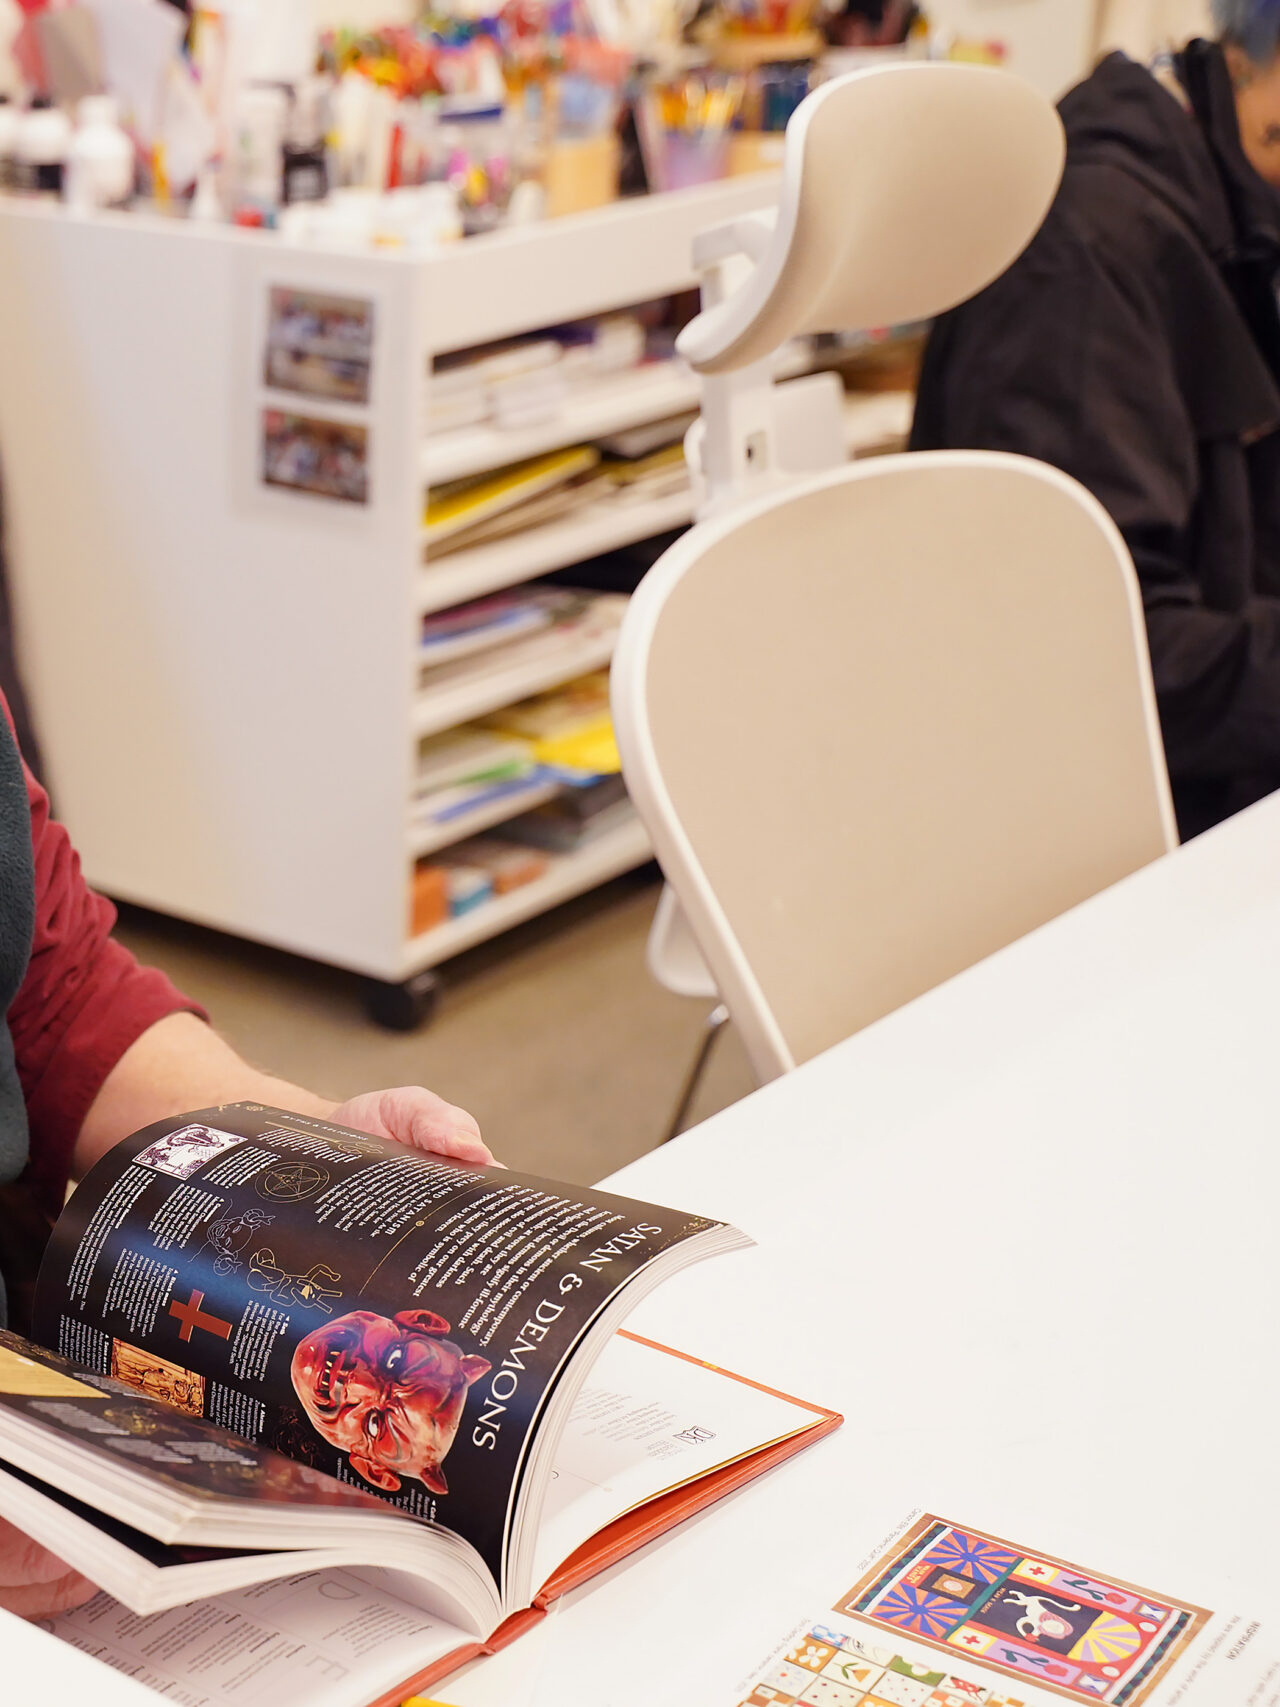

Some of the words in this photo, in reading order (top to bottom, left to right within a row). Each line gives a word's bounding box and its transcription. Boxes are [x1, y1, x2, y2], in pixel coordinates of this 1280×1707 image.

[454, 1174, 486, 1188] SATAN
[326, 1187, 348, 1203] originate
[351, 1192, 366, 1202] those
[432, 1187, 453, 1199] AND
[466, 1192, 499, 1209] opposed
[532, 1194, 560, 1206] figures
[314, 1204, 329, 1214] from
[340, 1201, 353, 1211] who
[353, 1196, 374, 1208] During
[379, 1203, 399, 1217] Heaven
[482, 1194, 516, 1214] especially
[316, 1206, 336, 1223] popular
[333, 1208, 356, 1227] medieval
[362, 1210, 378, 1221] Satan
[383, 1198, 433, 1235] SATANISM
[463, 1211, 486, 1225] Satan
[510, 1210, 527, 1219] also
[523, 1199, 572, 1223] manifestations
[552, 1206, 571, 1216] poor
[553, 1210, 586, 1228] religion.
[586, 1211, 613, 1222] feature
[342, 1221, 353, 1230] and
[434, 1211, 465, 1234] Heaven.
[449, 1223, 468, 1237] who
[470, 1220, 491, 1233] they
[369, 1229, 380, 1237] the
[455, 1231, 474, 1246] prey
[477, 1218, 514, 1244] associated
[503, 1226, 520, 1237] evil
[532, 1231, 551, 1243] best
[556, 1227, 579, 1239] Devil
[575, 1222, 608, 1240] cultures,
[442, 1235, 454, 1244] is
[489, 1236, 507, 1248] and
[504, 1234, 528, 1252] worst
[578, 1222, 662, 1272] SATAN
[447, 1245, 460, 1256] on
[461, 1242, 482, 1258] with
[488, 1248, 510, 1266] they
[507, 1242, 537, 1266] demons
[523, 1244, 553, 1268] demons
[551, 1238, 582, 1260] whether
[412, 1240, 447, 1275] symbolic
[435, 1254, 450, 1268] our
[469, 1246, 495, 1269] death.
[407, 1271, 419, 1284] of
[434, 1256, 467, 1291] darkness
[454, 1266, 475, 1287] Such
[479, 1264, 493, 1276] are
[485, 1262, 512, 1290] signify
[515, 1266, 528, 1277] in
[527, 1258, 555, 1283] ancient
[166, 1276, 176, 1292] Black
[410, 1265, 440, 1300] greatest
[500, 1274, 521, 1294] their
[519, 1280, 530, 1291] or
[558, 1272, 583, 1295] &
[161, 1292, 169, 1306] mass
[240, 1305, 251, 1326] describe
[249, 1302, 259, 1320] derives
[277, 1312, 285, 1320] For
[457, 1287, 492, 1331] ill-fortune
[468, 1290, 505, 1337] mythology
[266, 1319, 274, 1331] Seth
[279, 1322, 288, 1335] Seth
[233, 1325, 243, 1346] worship
[267, 1329, 278, 1348] Ancient
[243, 1336, 254, 1359] Satanism
[259, 1348, 271, 1372] Egyptians
[232, 1362, 240, 1375] used
[237, 1359, 249, 1380] probably
[471, 1299, 566, 1450] DEMONS
[1225, 1620, 1262, 1661] INSPIRATION
